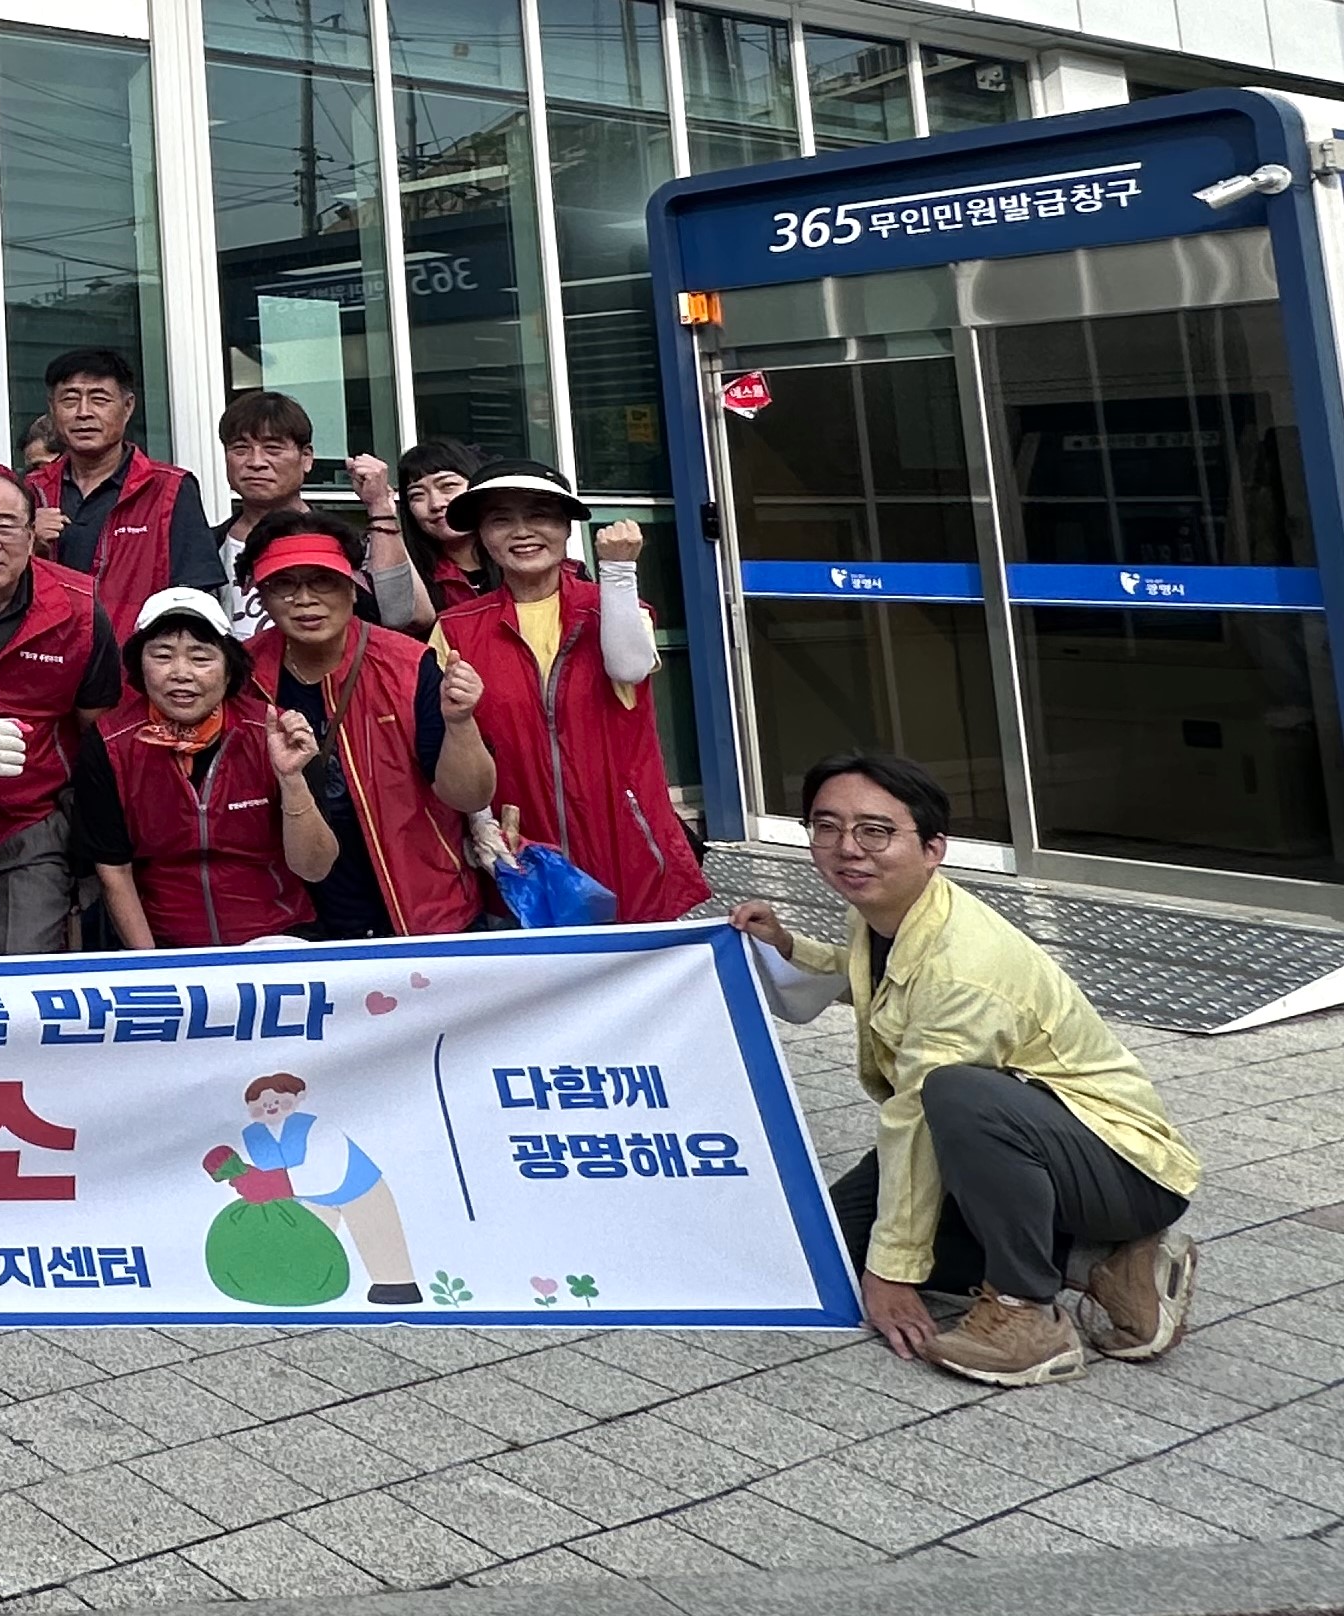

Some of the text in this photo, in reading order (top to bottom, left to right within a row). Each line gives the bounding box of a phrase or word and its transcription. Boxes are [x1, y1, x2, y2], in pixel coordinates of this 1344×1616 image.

[768, 179, 1143, 253] 365 무인민원발급창구
[31, 981, 335, 1045] 만듭니다
[492, 1065, 669, 1110] 다함께
[510, 1133, 750, 1179] 광명해요
